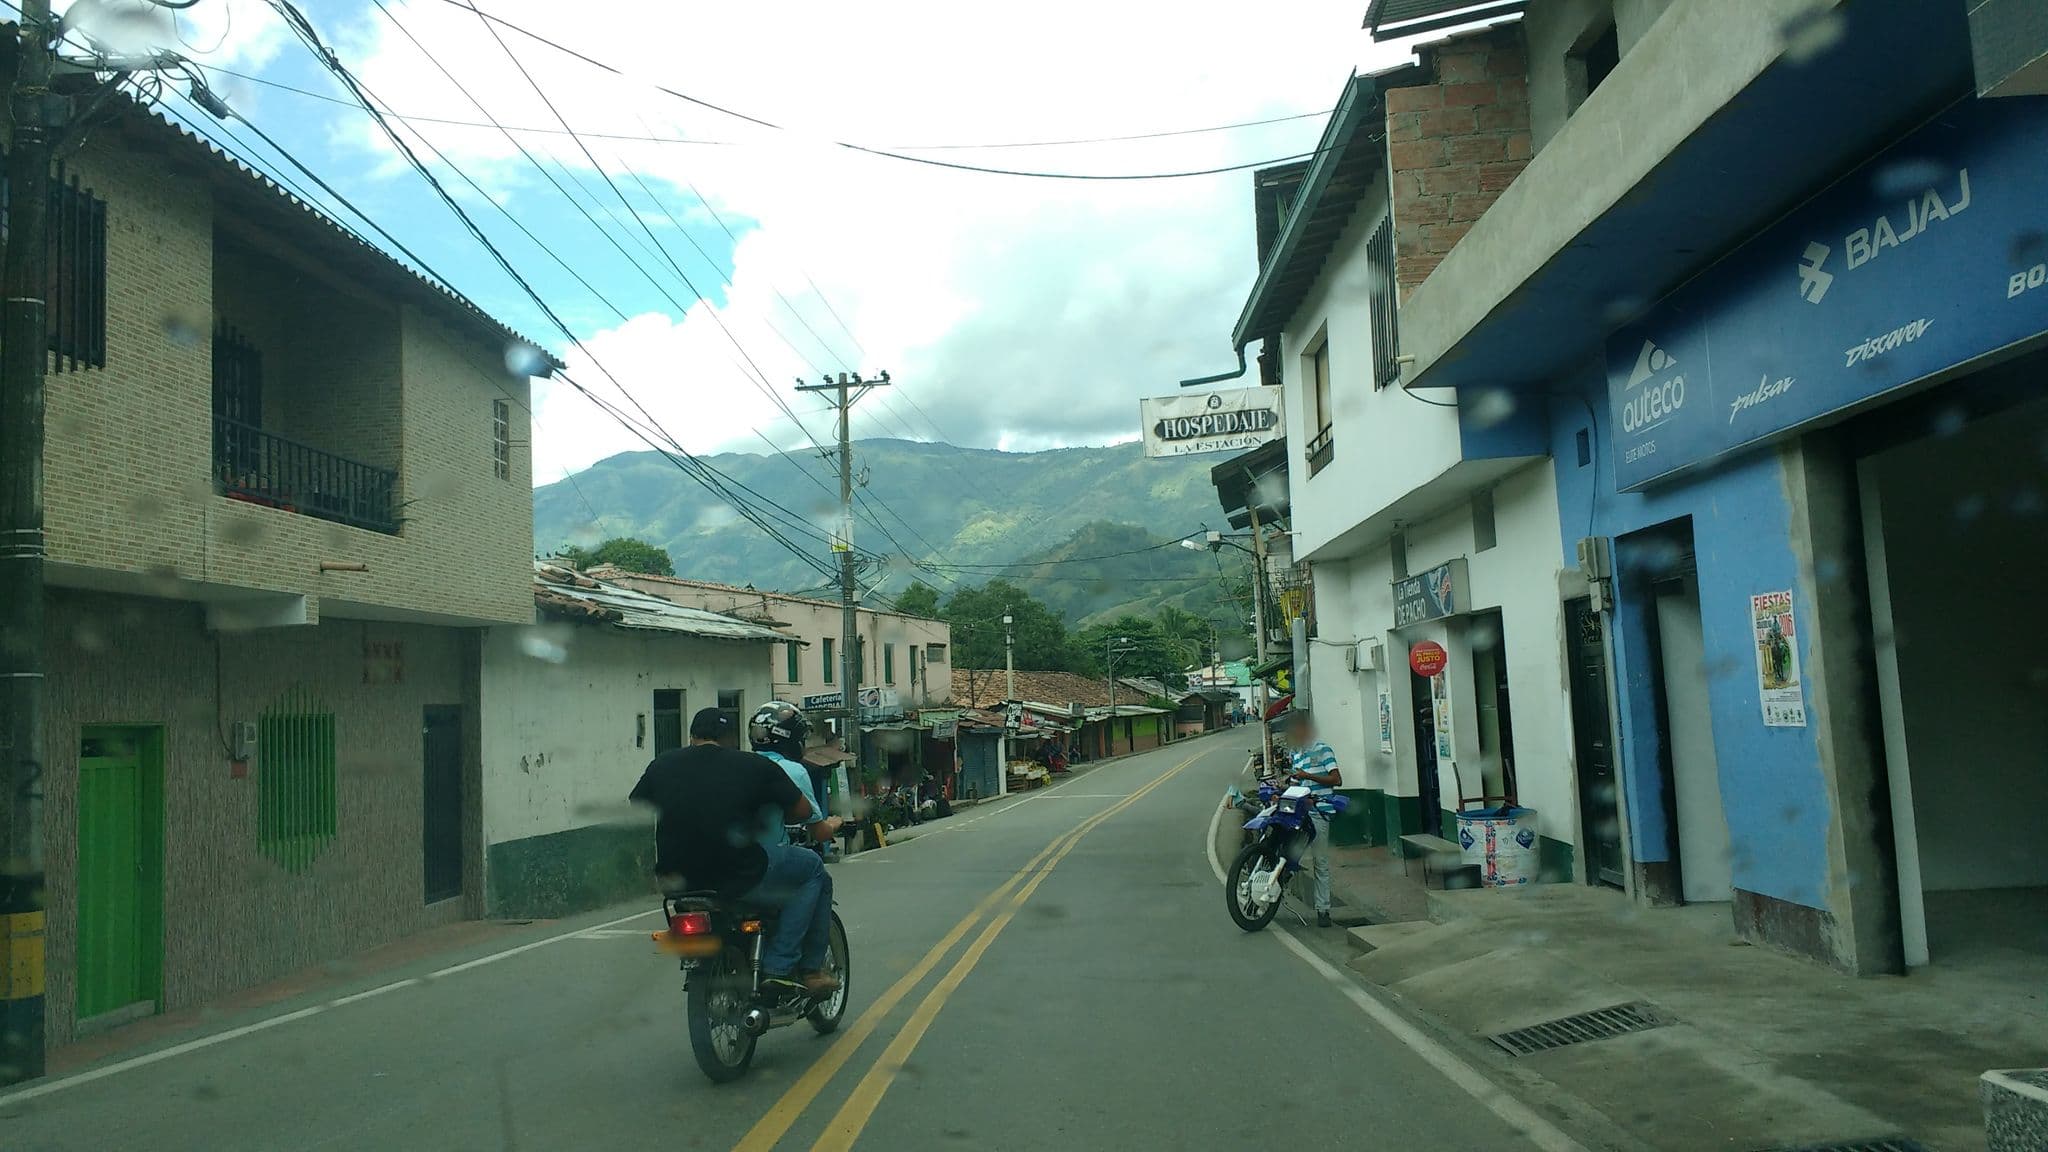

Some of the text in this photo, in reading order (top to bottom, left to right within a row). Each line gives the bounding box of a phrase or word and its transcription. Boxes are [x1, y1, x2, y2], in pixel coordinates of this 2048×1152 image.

[1845, 168, 1970, 271] BAJAJ
[2007, 263, 2048, 299] BO
[1623, 375, 1684, 433] auteco
[1729, 373, 1797, 424] pulsar
[1163, 409, 1270, 439] HOSPEDAJE
[1174, 434, 1262, 453] LA ESTACIÓN
[1398, 583, 1404, 600] La
[1404, 577, 1421, 598] Tienda
[1753, 592, 1791, 611] FIESTAS
[1398, 597, 1426, 626] DE PACHO
[1416, 655, 1440, 664] JUSTO
